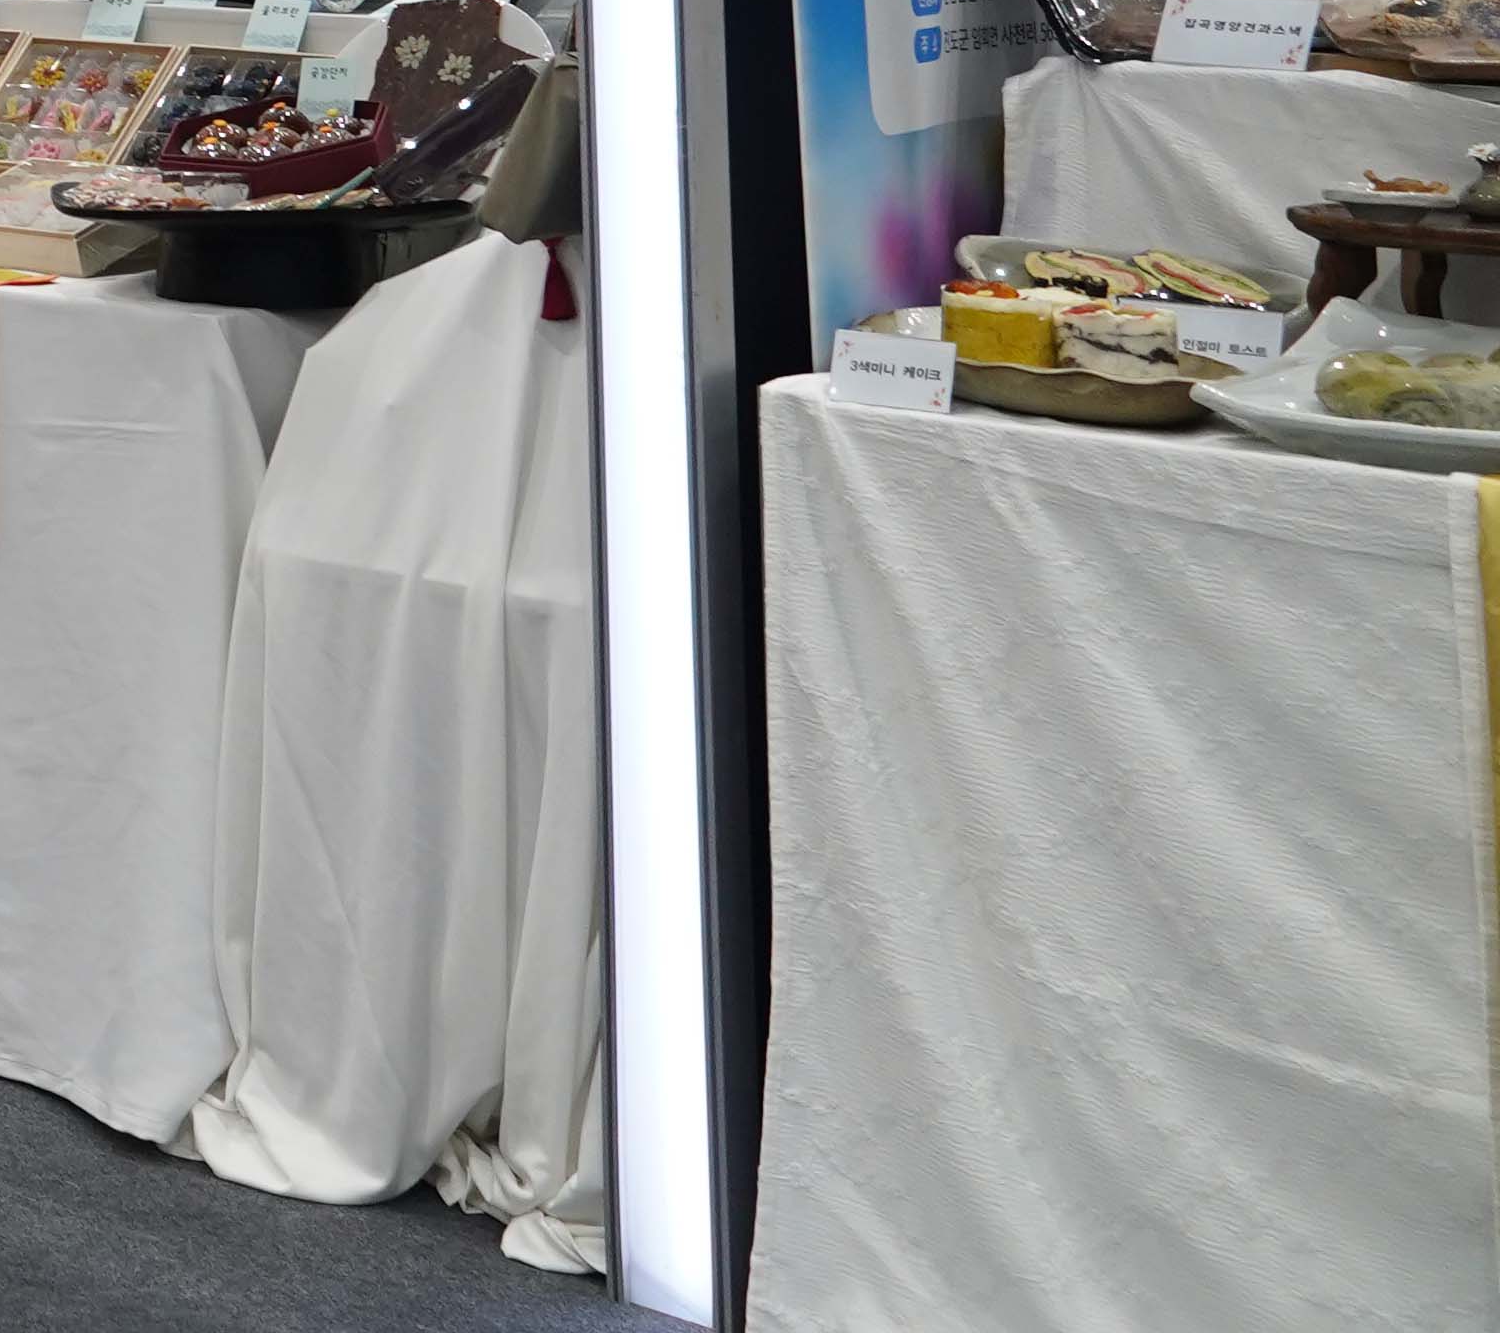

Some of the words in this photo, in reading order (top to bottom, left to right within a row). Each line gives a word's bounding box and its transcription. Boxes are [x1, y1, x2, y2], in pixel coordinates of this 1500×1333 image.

[1182, 336, 1221, 354] 인절미
[1227, 341, 1268, 358] 토스트
[849, 358, 896, 378] 3색미니
[902, 362, 943, 382] 케이크
